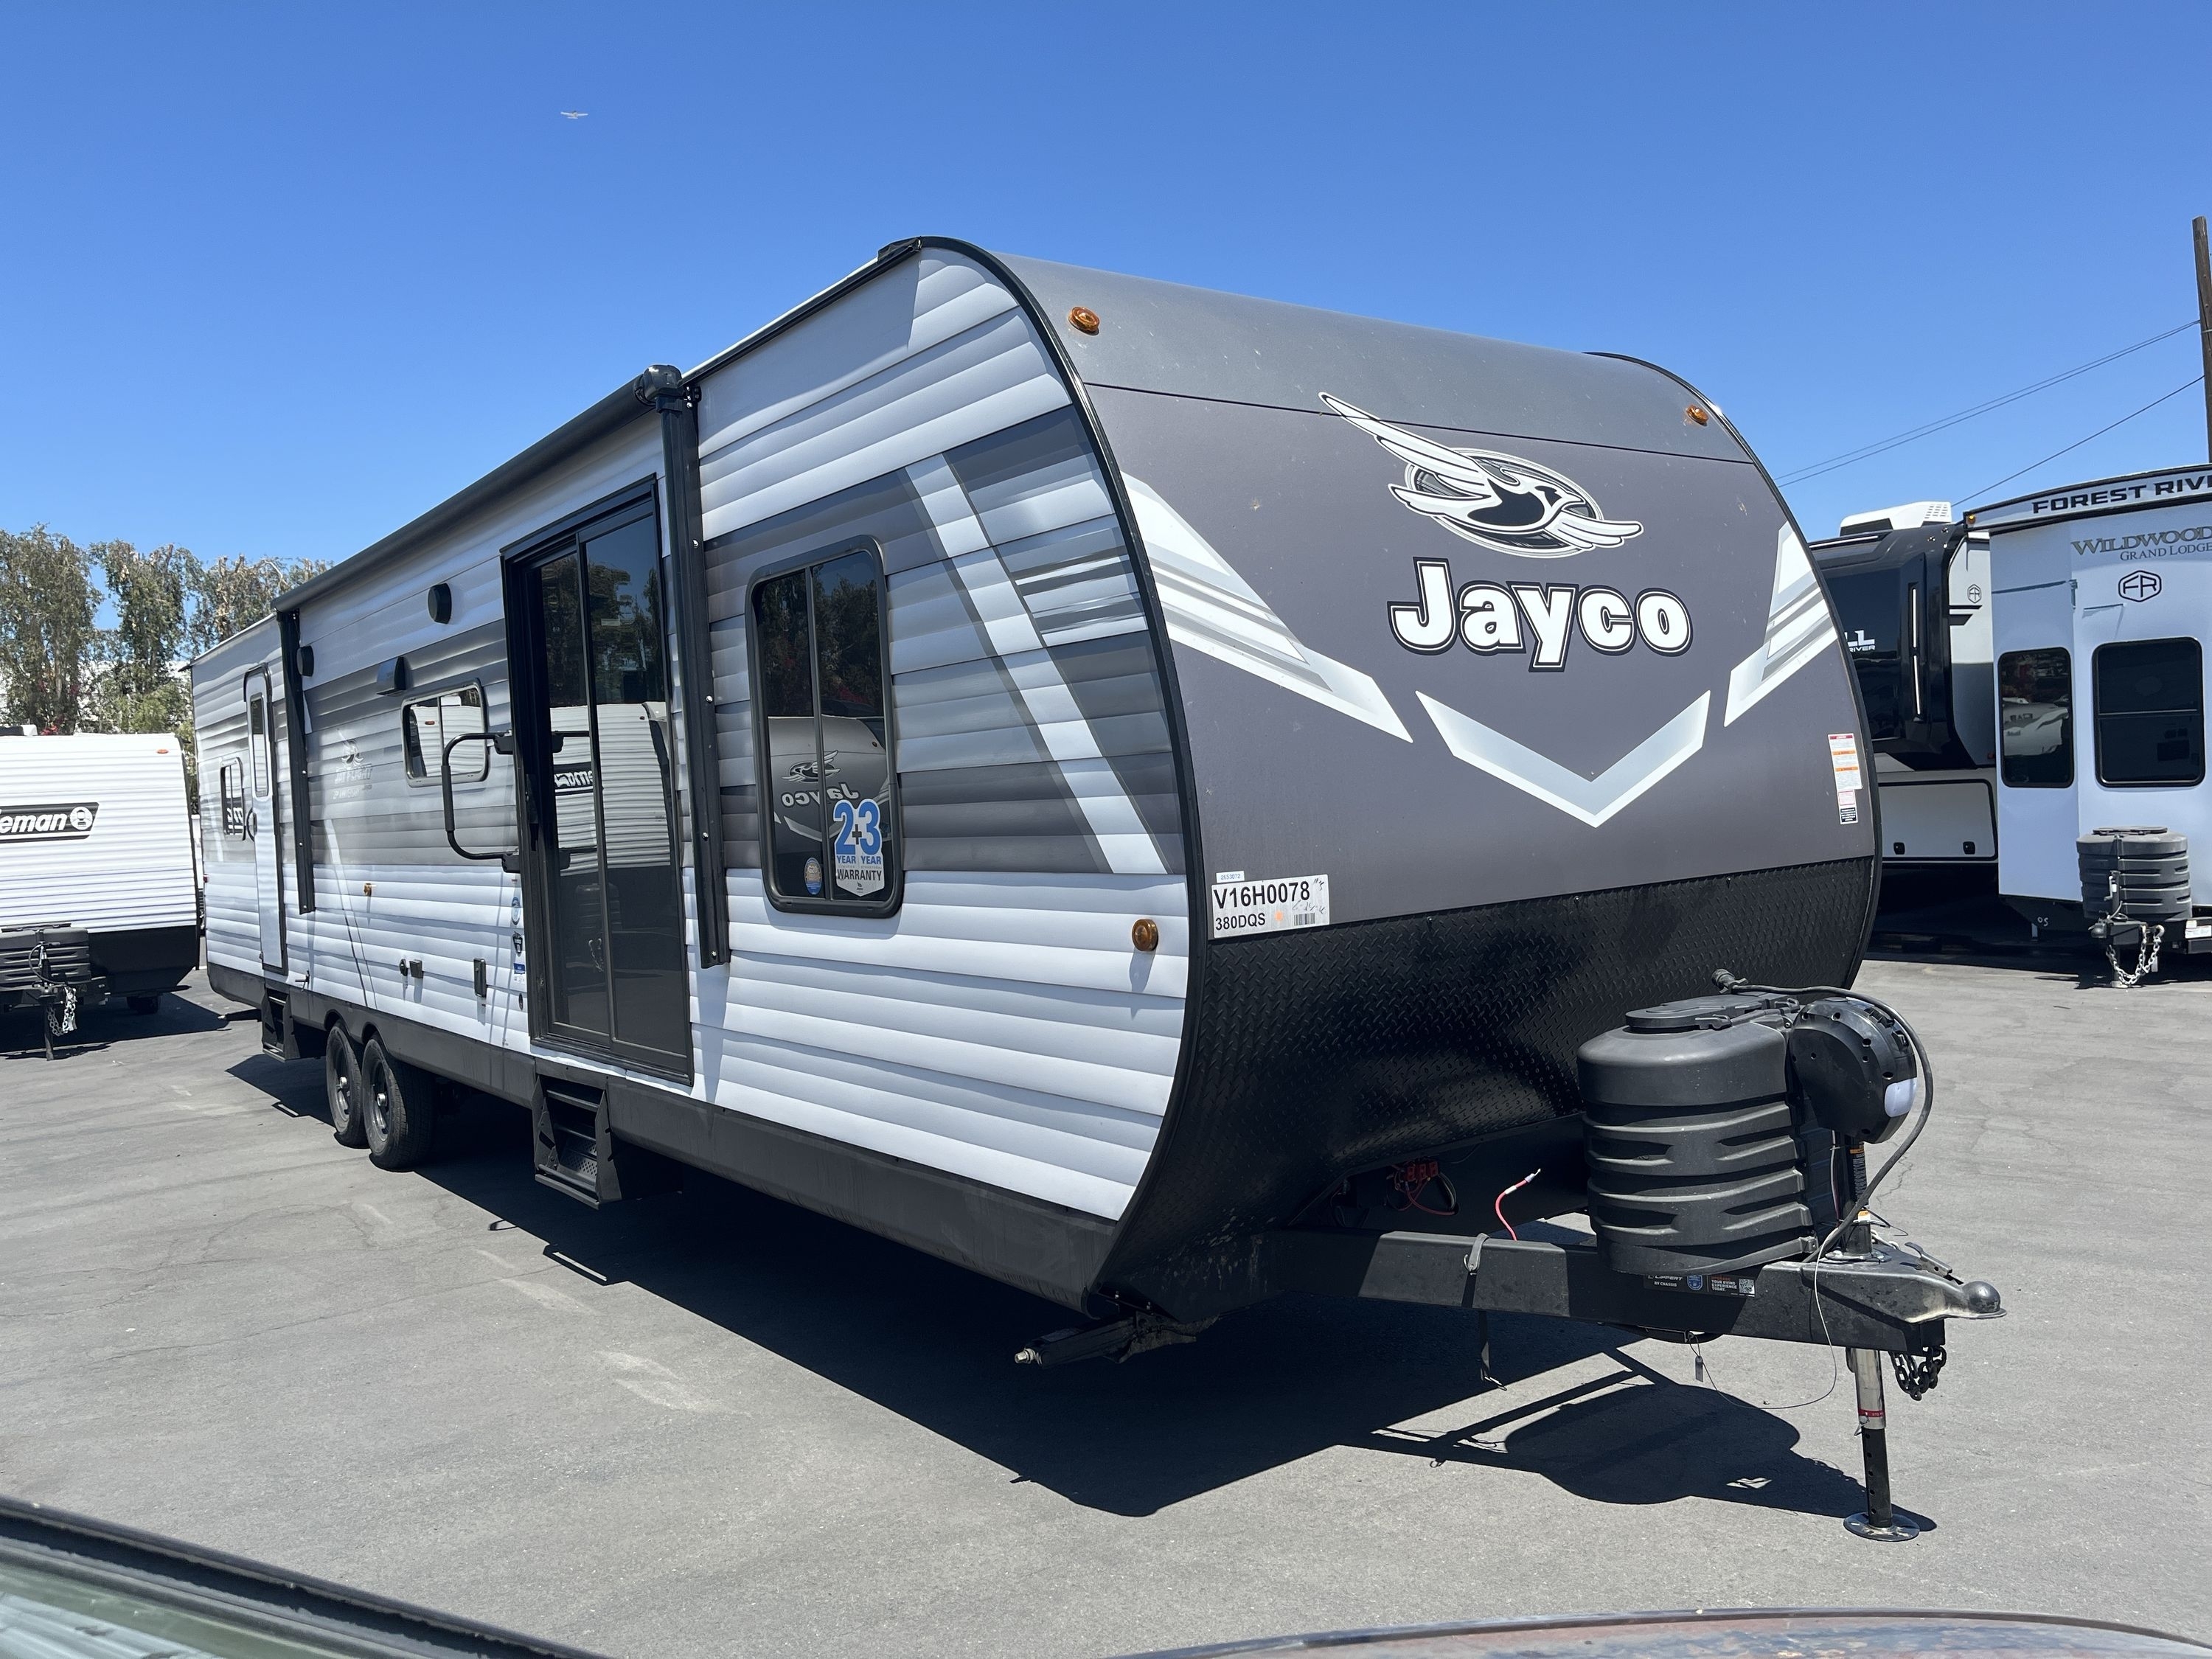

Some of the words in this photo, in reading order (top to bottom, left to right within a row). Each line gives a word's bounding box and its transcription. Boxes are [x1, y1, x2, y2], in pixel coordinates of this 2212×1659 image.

[2032, 484, 2146, 514] FOREST
[2070, 526, 2212, 555] WILDWOOD
[2120, 548, 2167, 561] GRAND
[2170, 542, 2212, 555] LODGE
[1387, 557, 1694, 672] Jayco
[0, 810, 67, 833] eman
[837, 855, 856, 863] YEAR
[861, 856, 881, 865] YEAR
[837, 869, 882, 881] WARRANTY
[1213, 880, 1310, 909] V16H0078
[1215, 912, 1265, 931] 380DQS
